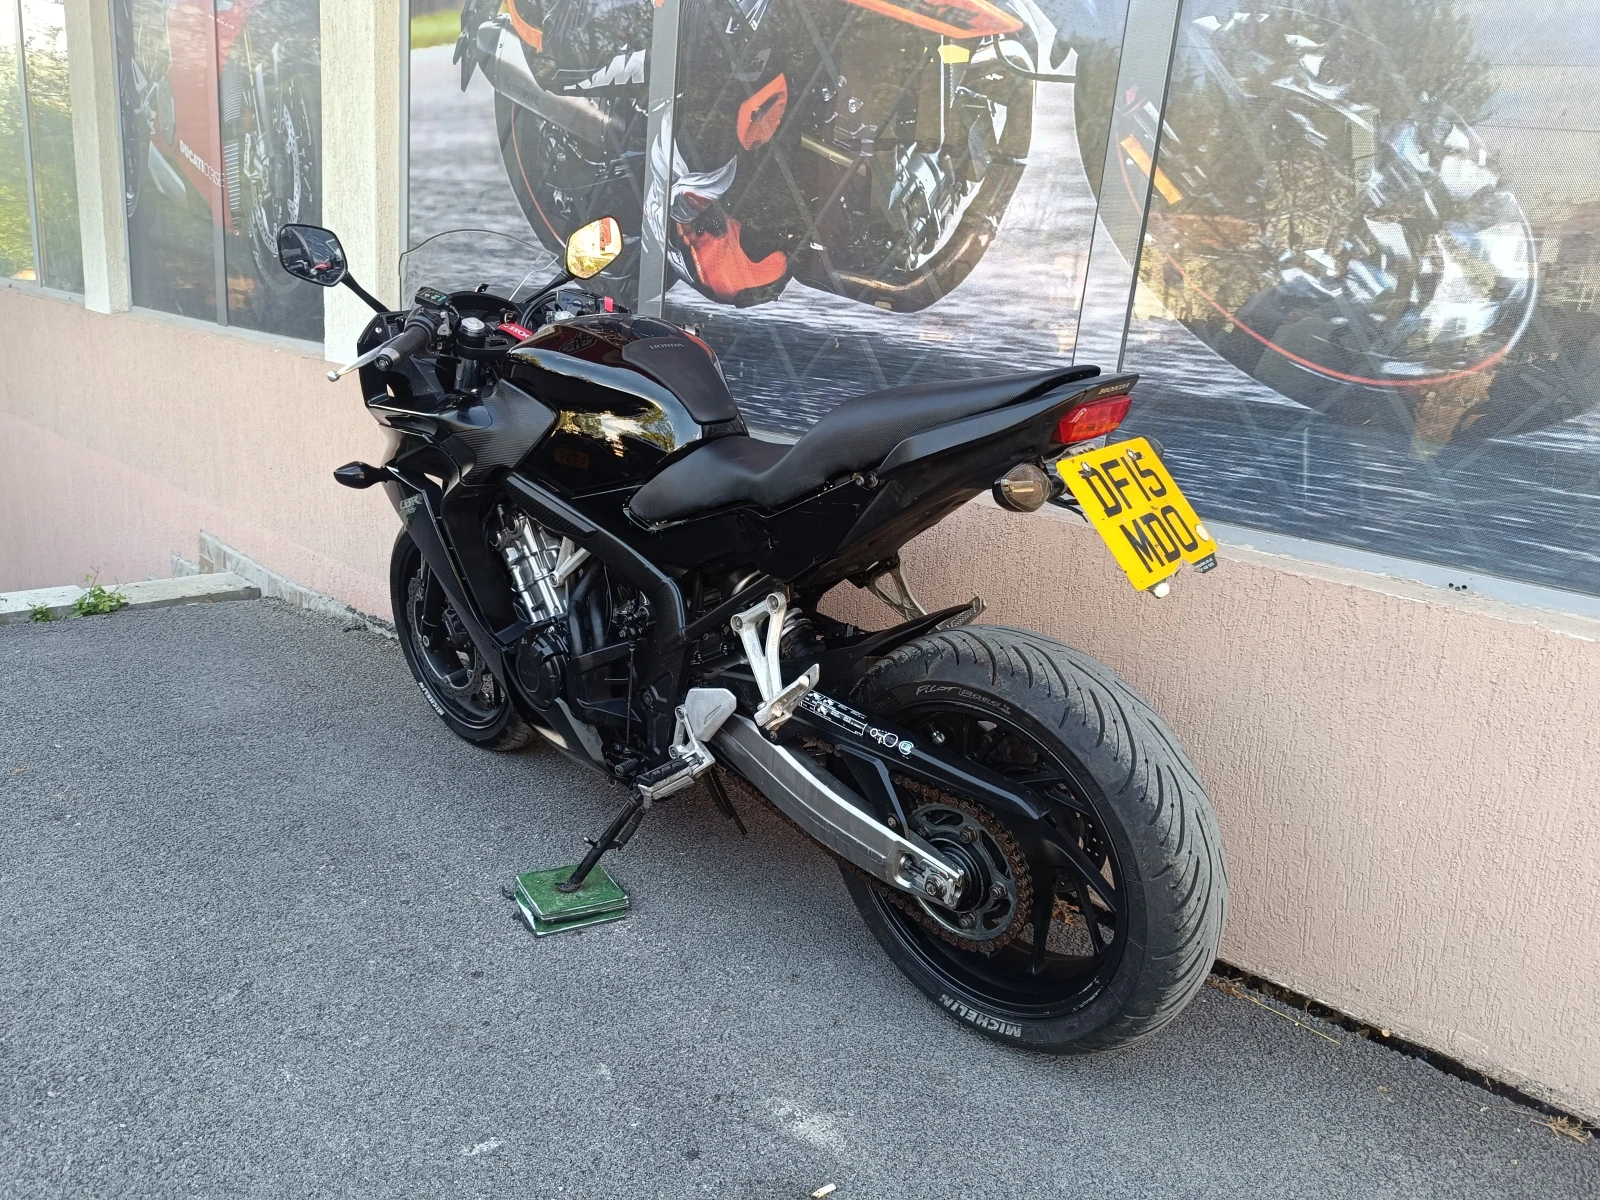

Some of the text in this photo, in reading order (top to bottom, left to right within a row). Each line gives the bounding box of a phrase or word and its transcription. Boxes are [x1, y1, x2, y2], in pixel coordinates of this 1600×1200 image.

[180, 139, 205, 173] DUCATI
[1098, 382, 1130, 395] HONDA
[1078, 451, 1167, 518] DF15
[1119, 504, 1199, 574] MDO
[418, 681, 446, 716] MICHELIN
[938, 993, 1023, 1038] MICHELIN
